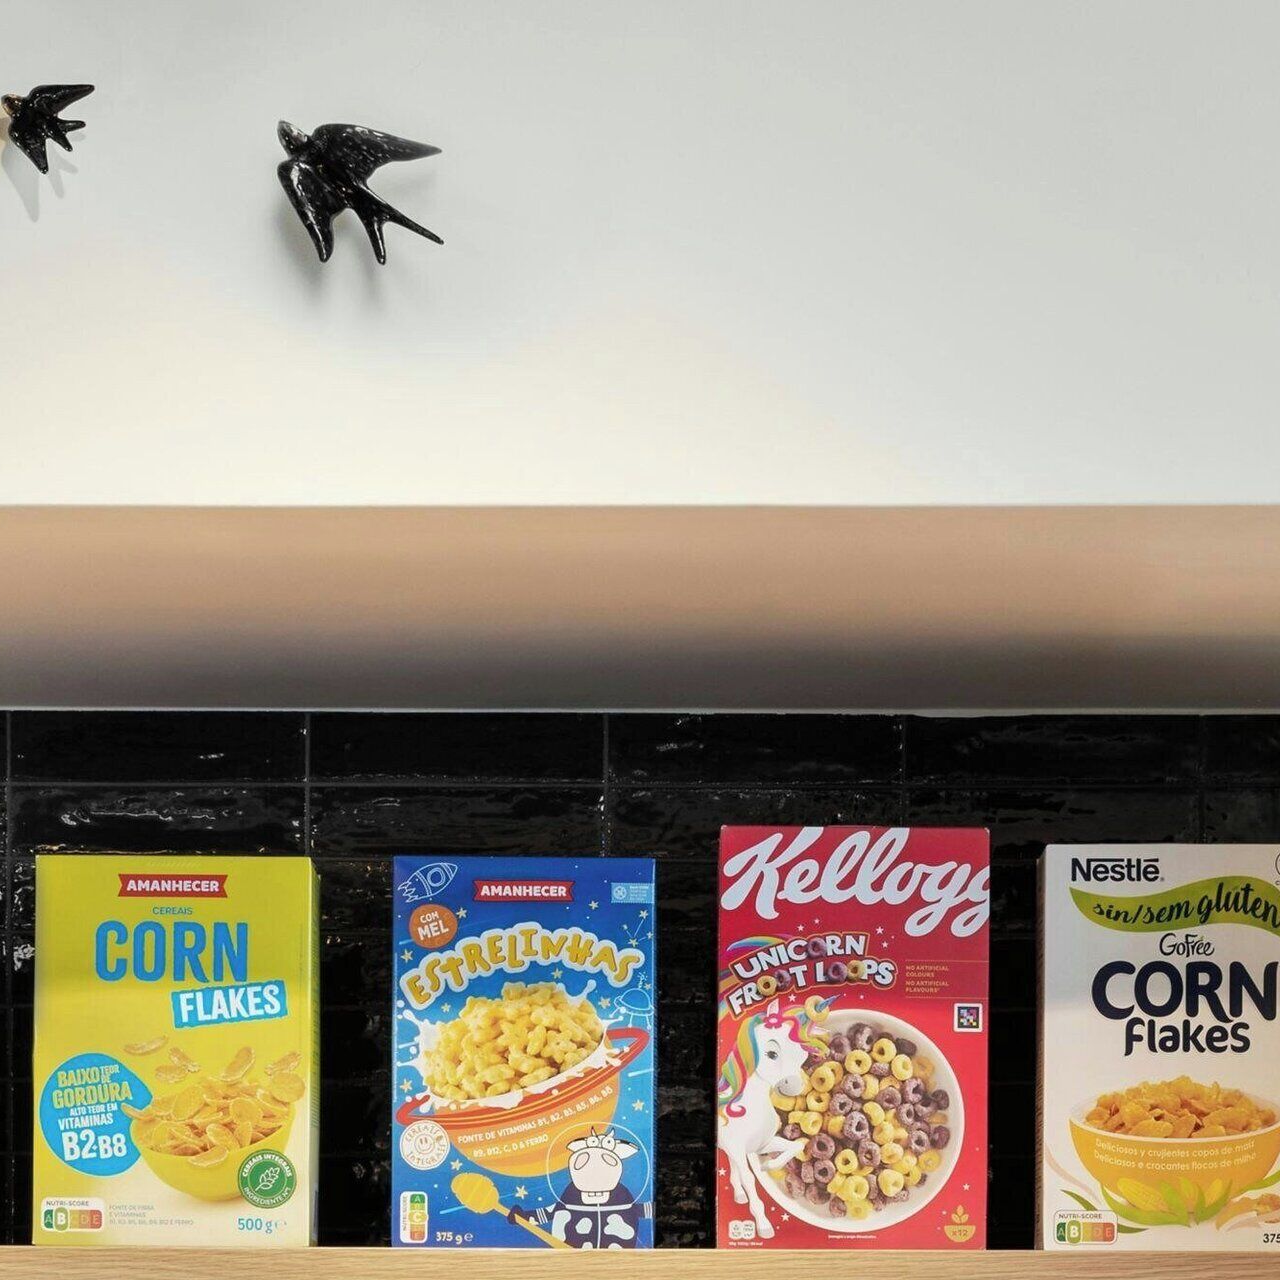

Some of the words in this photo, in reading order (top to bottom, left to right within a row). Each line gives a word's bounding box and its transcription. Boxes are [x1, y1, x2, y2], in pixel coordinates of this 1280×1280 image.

[1071, 857, 1160, 882] Nestlé
[126, 879, 220, 893] AMANHECER
[480, 884, 567, 898] AMANHECER
[152, 906, 193, 915] CEREAIS
[419, 909, 439, 925] COM
[417, 919, 450, 941] MEL
[95, 920, 248, 983] CORN
[733, 934, 865, 979] UNICORN
[402, 926, 642, 1004] ESTRELINHAS
[728, 963, 808, 1015] FROOT
[816, 959, 896, 986] LOOPS
[1091, 960, 1279, 1024] CORN
[179, 985, 282, 1023] FLAKES
[57, 1066, 100, 1088] BAIXO
[52, 1081, 133, 1109] GORDURA
[58, 1113, 114, 1130] VITAMINAS
[70, 1105, 87, 1116] ALTO
[458, 1132, 484, 1144] FONTE
[485, 1131, 496, 1140] DE
[497, 1121, 537, 1138] VITAMINAS
[1095, 1138, 1138, 1156] Deliciosos
[1147, 1149, 1190, 1159] crujientes
[1192, 1148, 1219, 1158] copos
[1221, 1146, 1233, 1155] de
[1094, 1150, 1136, 1168] Deliciosos
[1145, 1160, 1190, 1171] crocantes
